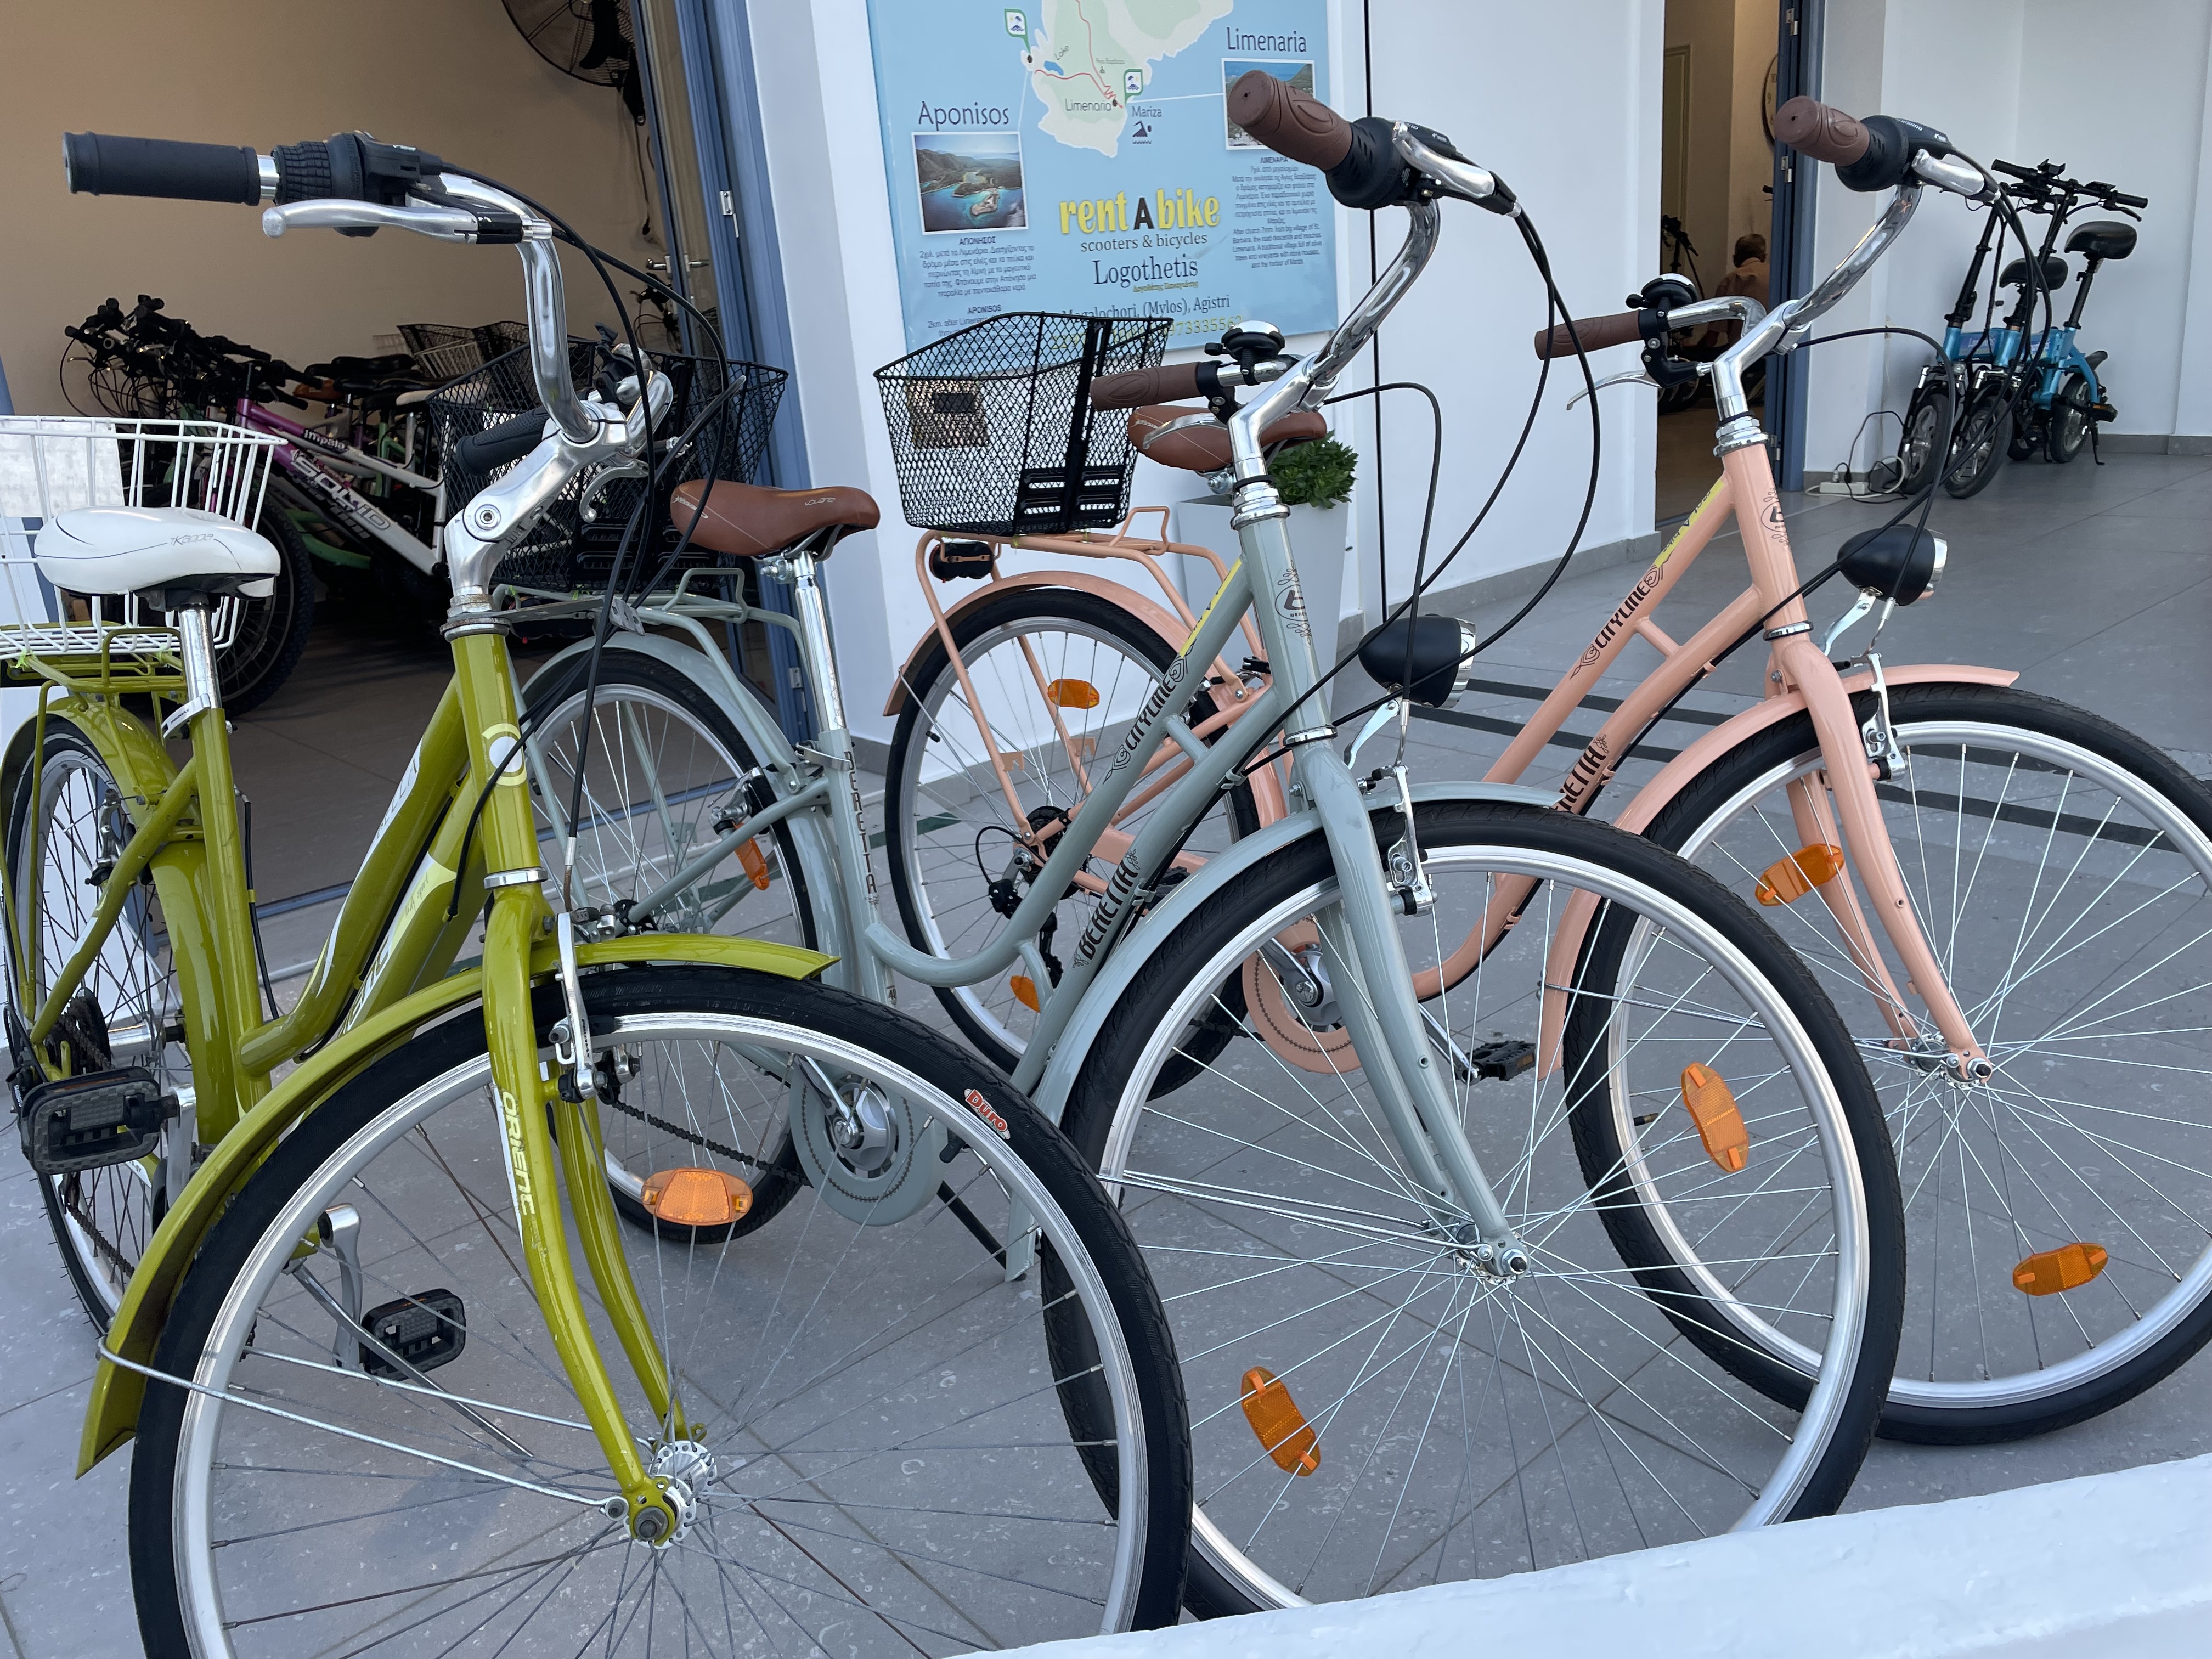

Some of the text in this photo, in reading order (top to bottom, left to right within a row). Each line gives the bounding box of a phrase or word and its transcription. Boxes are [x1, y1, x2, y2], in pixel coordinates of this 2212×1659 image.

[1054, 46, 1069, 60] Lake
[1226, 27, 1307, 53] Limenaria
[918, 101, 1010, 129] Aponisos
[1132, 106, 1162, 117] Mariza
[1059, 188, 1220, 234] rent A bike
[1080, 232, 1207, 252] scooters & bicycles
[1092, 253, 1198, 288] Logothetis
[967, 304, 1002, 314] APONISOS
[1142, 298, 1191, 317] (Mylos),
[1193, 294, 1231, 311] Agistri
[290, 455, 391, 531] SOLID
[1595, 581, 1650, 651] CITYLINE
[1125, 679, 1177, 752] CITYLINE
[1555, 746, 1606, 810] RETTA
[844, 751, 877, 894] BERETTA
[1079, 860, 1139, 960] BERETTA
[965, 1089, 1008, 1132] Duro
